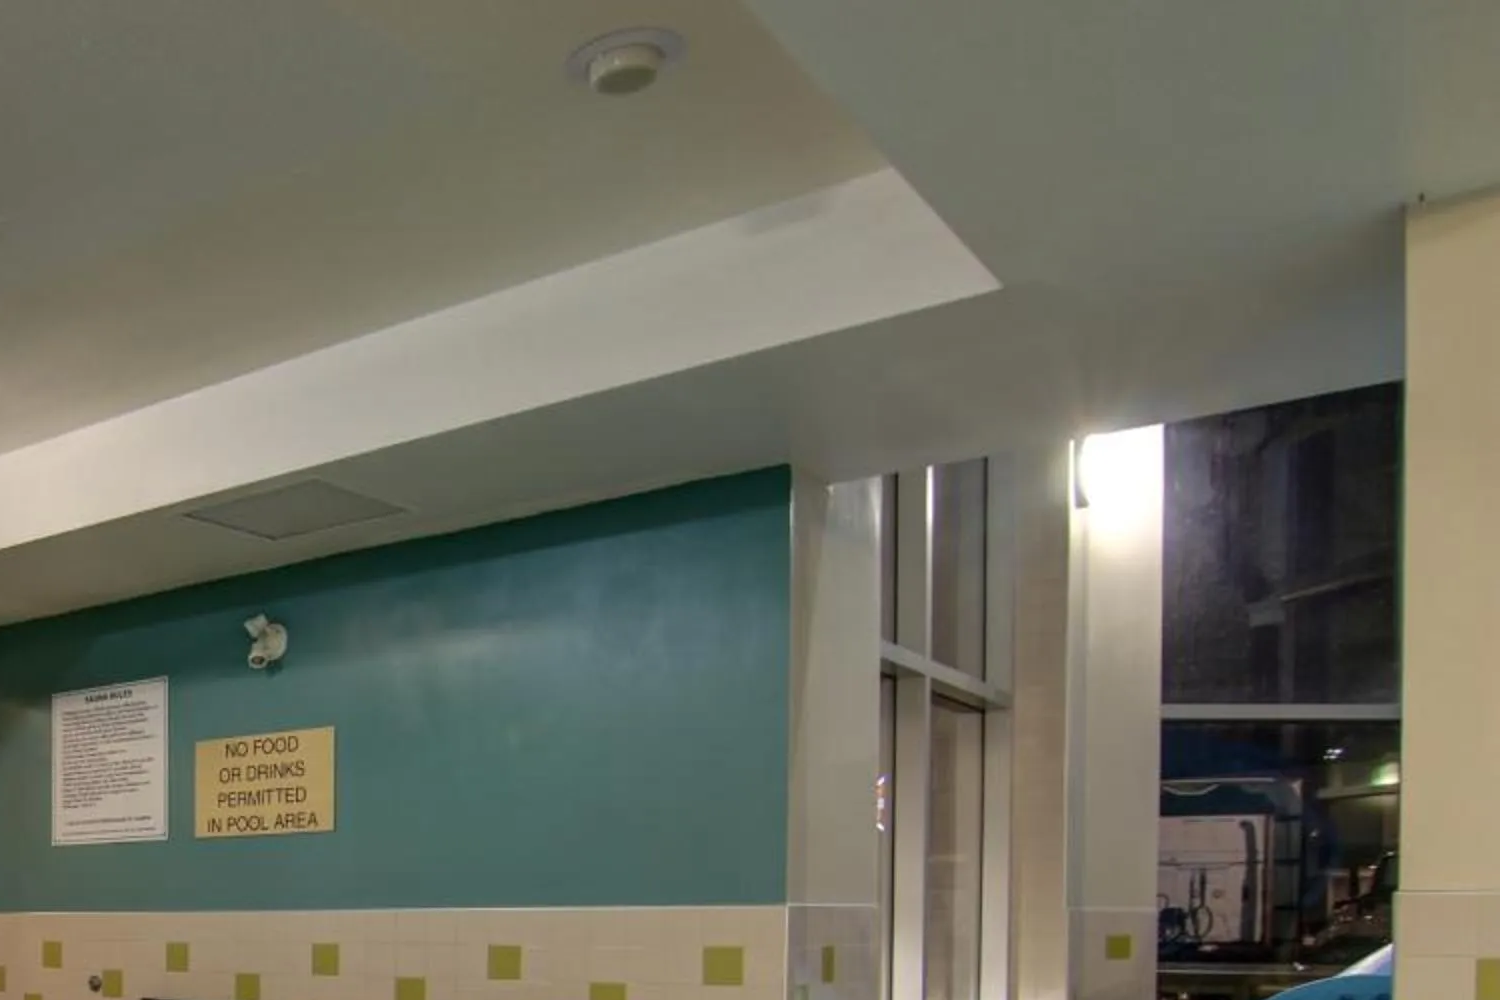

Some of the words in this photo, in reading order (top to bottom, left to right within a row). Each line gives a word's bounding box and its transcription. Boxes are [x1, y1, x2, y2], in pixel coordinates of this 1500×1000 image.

[225, 741, 249, 758] NO
[253, 735, 299, 756] FOOD
[219, 767, 243, 784] OR
[246, 760, 305, 782] DRINKS
[217, 787, 307, 808] PERMITTED
[207, 818, 222, 833] IN
[227, 815, 269, 832] POOL
[274, 812, 319, 830] AREA
